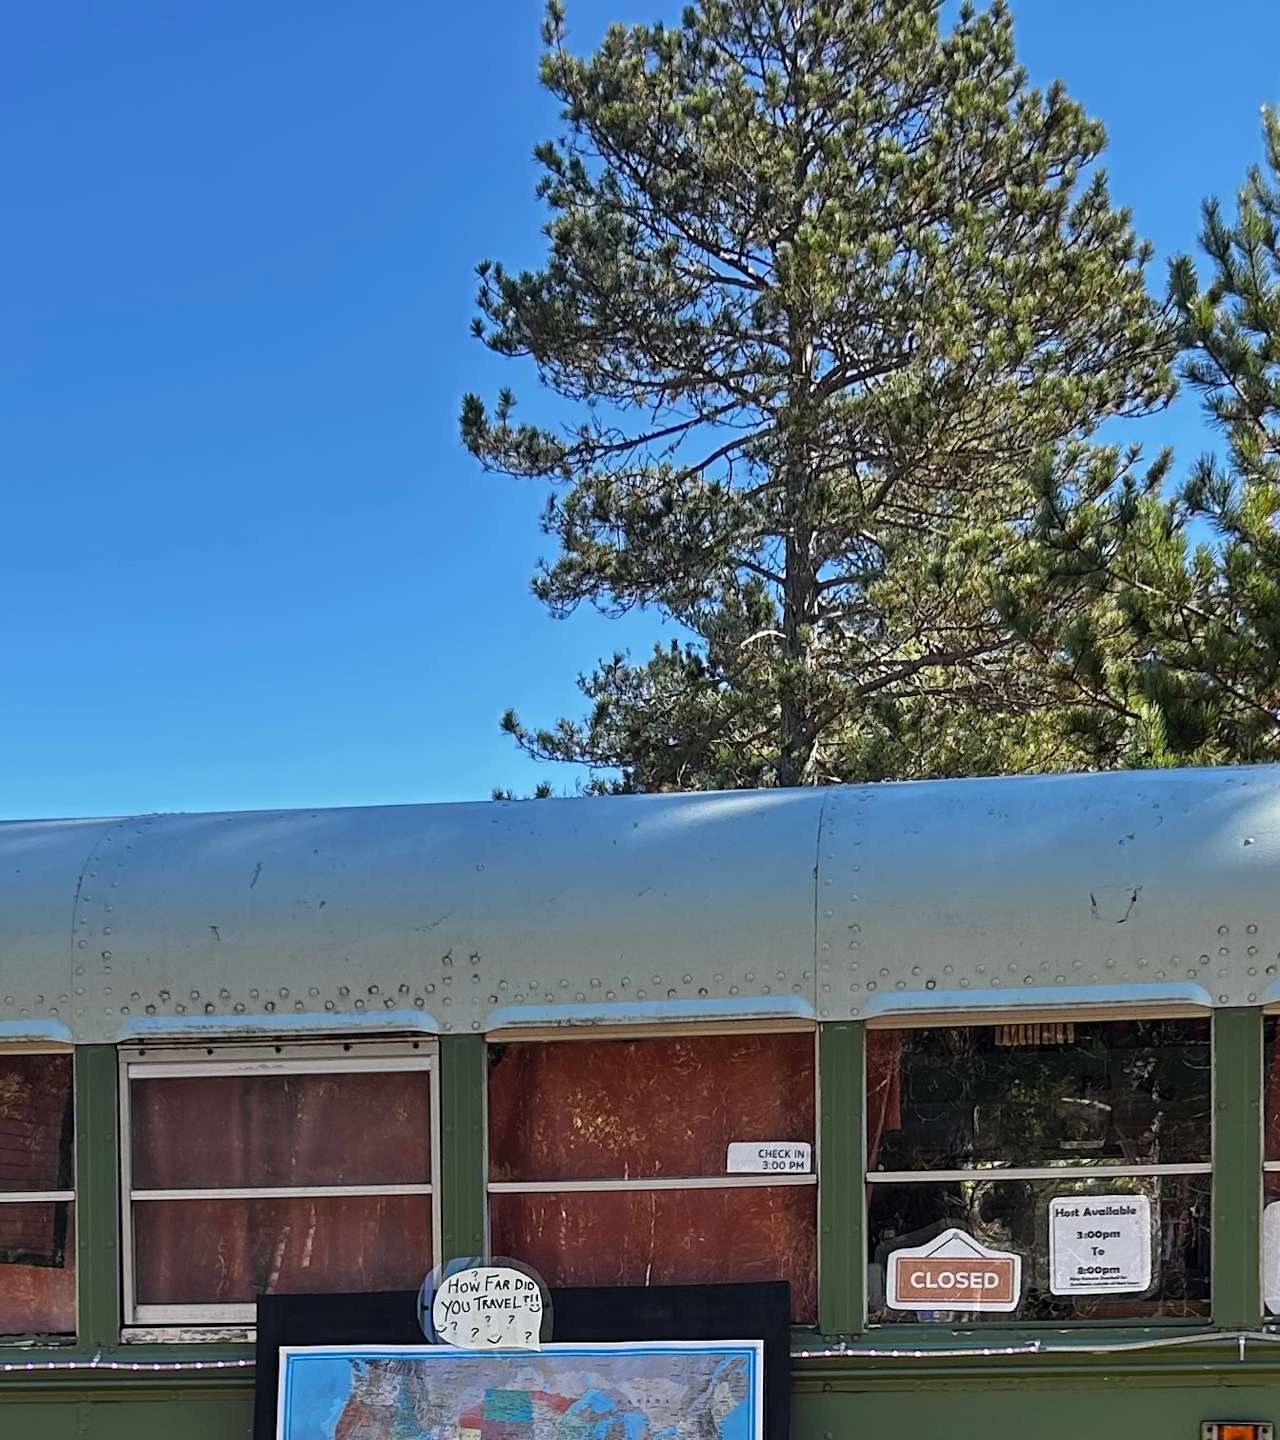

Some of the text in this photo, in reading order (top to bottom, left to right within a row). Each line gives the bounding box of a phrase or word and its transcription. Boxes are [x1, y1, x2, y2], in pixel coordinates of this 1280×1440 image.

[758, 1149, 805, 1159] CHECK IN
[762, 1160, 805, 1170] 3:00 PM
[1055, 1206, 1137, 1217] Host Available
[1091, 1246, 1105, 1256] To
[515, 1278, 535, 1291] DID
[910, 1271, 1000, 1289] CLOSED
[441, 1300, 470, 1322] YOU
